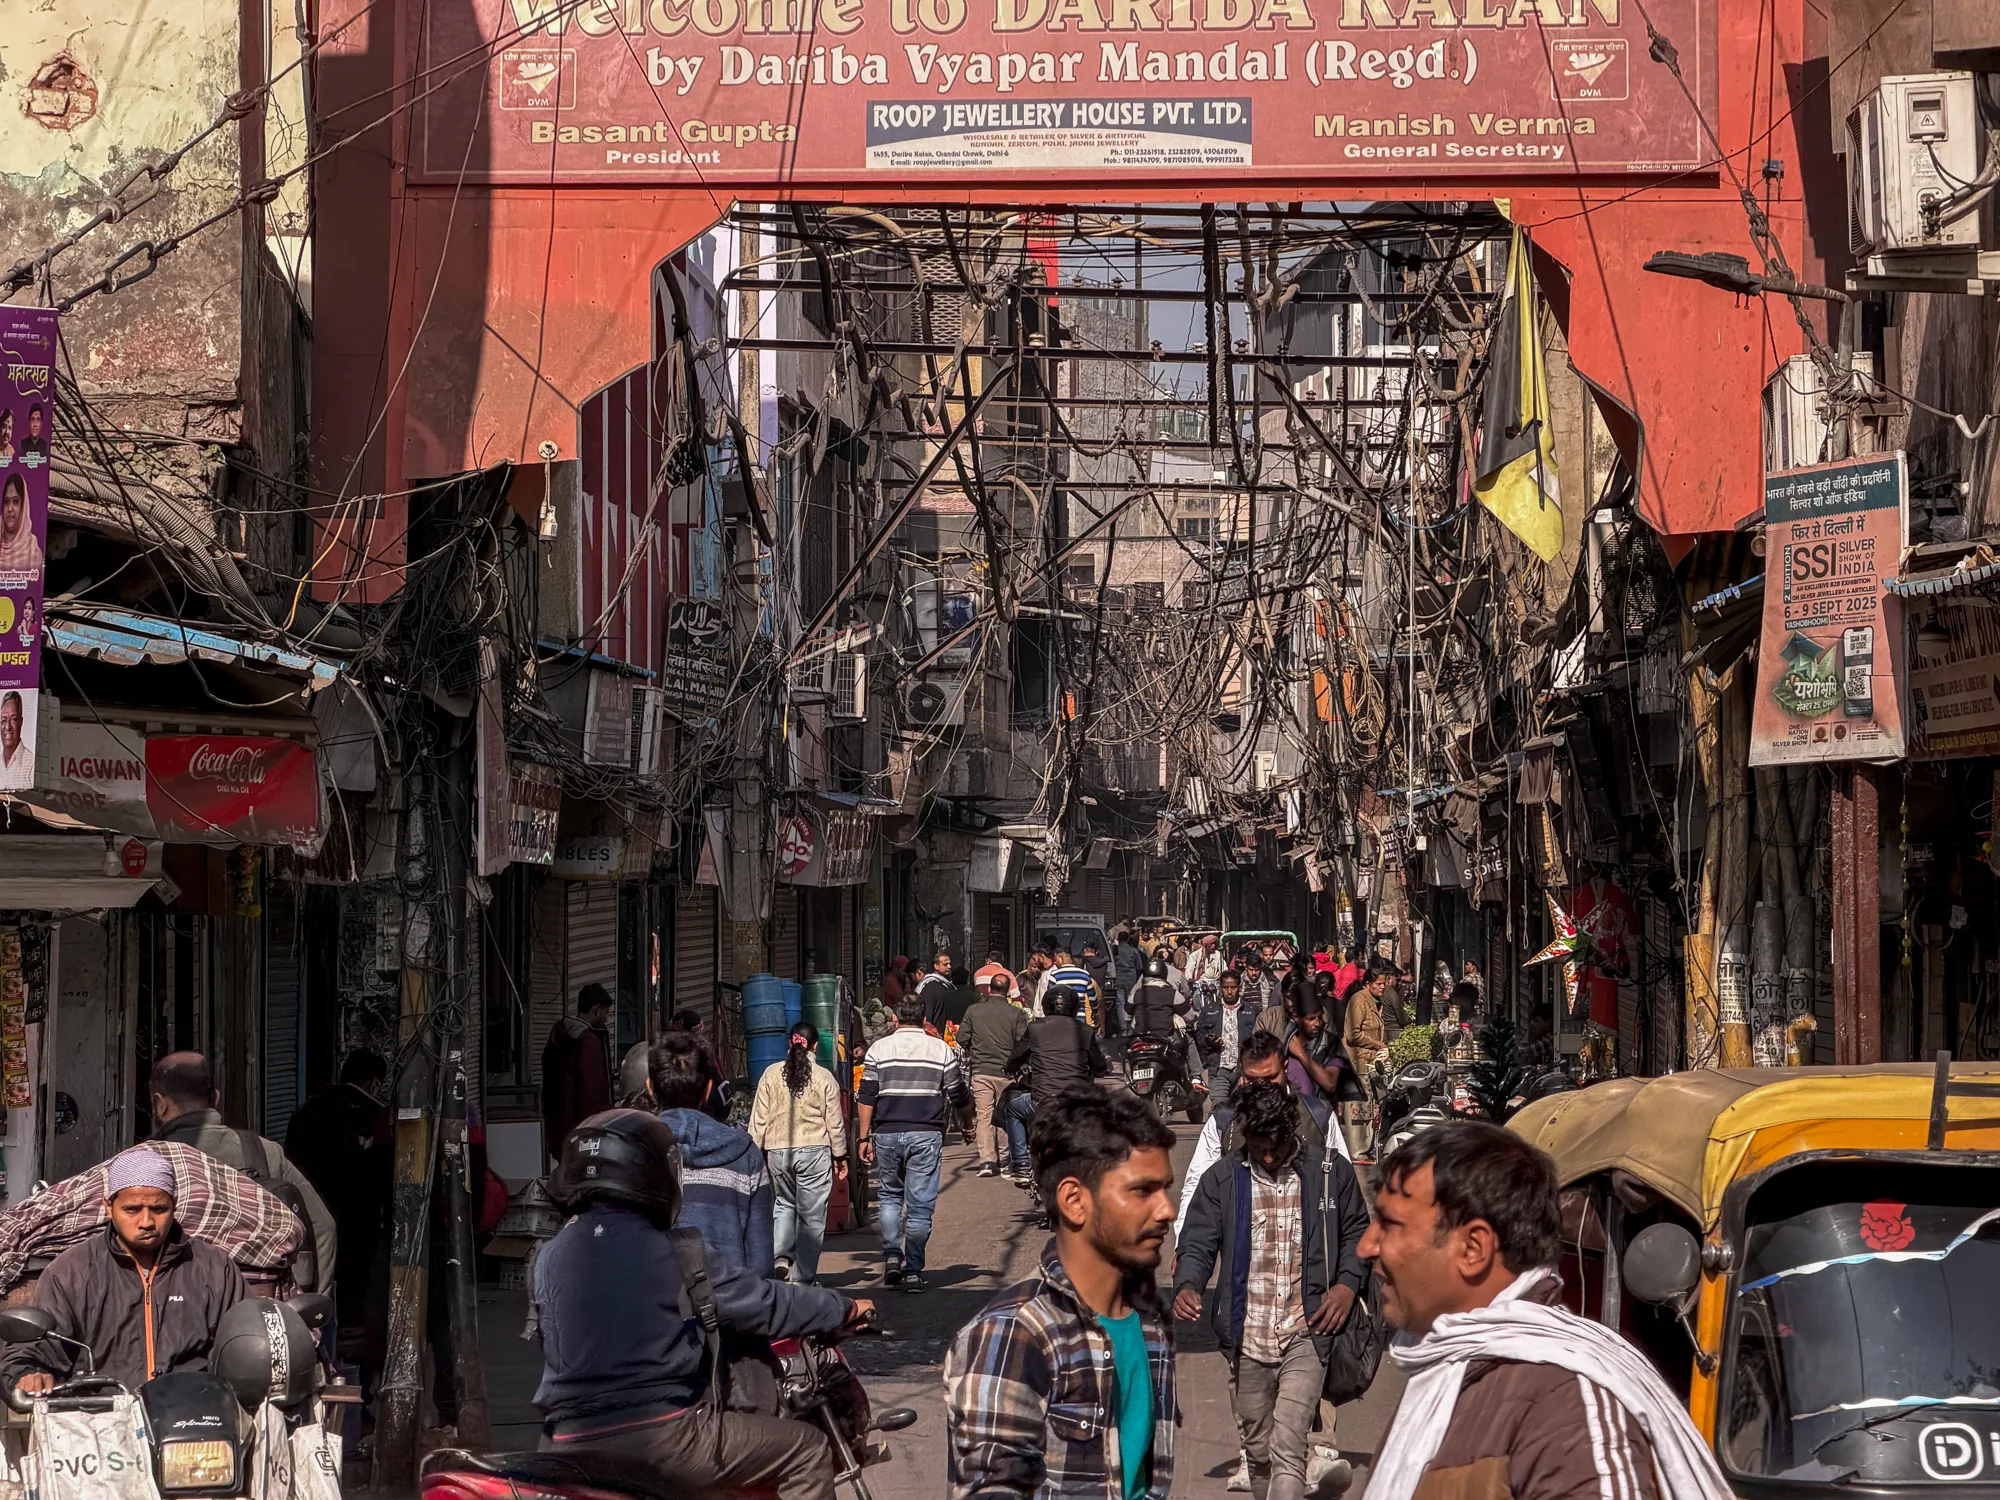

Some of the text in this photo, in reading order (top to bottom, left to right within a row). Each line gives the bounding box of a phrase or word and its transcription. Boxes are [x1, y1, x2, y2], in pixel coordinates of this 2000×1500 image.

[889, 0, 970, 35] to
[646, 37, 1479, 96] by Dariba Vyapar Mandal (Regd.)
[1580, 88, 1602, 98] DVM
[527, 98, 549, 107] DVM
[873, 101, 1248, 133] ROOP JEWELLERY HOUSE PVT. LTD.
[1313, 112, 1597, 138] Manish Verma
[530, 119, 798, 148] Basant Gupta
[963, 133, 1009, 142] WHOLESALE
[1018, 133, 1055, 141] RETAILER
[1105, 132, 1147, 140] ARTIFICIAL
[970, 141, 1006, 149] KUNDAN,
[1096, 140, 1139, 148] JEWELLERY
[1110, 148, 1123, 156] Ph.:
[1344, 142, 1566, 160] General Secretary
[606, 150, 720, 164] President
[891, 150, 913, 158] Dariba
[914, 150, 934, 158] Kalan,
[935, 150, 961, 158] Chandni
[962, 150, 985, 158] Chowk,
[986, 150, 1010, 158] Delhi-6
[1766, 487, 1785, 500] भारत
[1786, 483, 1795, 497] की
[1797, 480, 1814, 494] सबसे
[1850, 472, 1861, 487] की
[1790, 489, 1866, 511] सिल्वर शो ऑफ इंडिया
[1791, 514, 1866, 541] फिर से दिल्ली में
[1839, 538, 1876, 554] SILVER
[1793, 542, 1837, 581] SSI
[1838, 551, 1876, 564] SHOW OF
[1784, 546, 1792, 590] EDITION
[1839, 560, 1876, 576] INDIA
[1804, 582, 1830, 592] EXCLUSIVE
[1841, 577, 1871, 587] EXHIBITION
[1792, 594, 1800, 602] ON
[1801, 591, 1816, 600] SILVER
[1816, 588, 1846, 598] JEWELLERY
[1851, 585, 1877, 595] ARTICLES
[1784, 605, 1791, 619] 6
[1802, 603, 1810, 616] 9
[1812, 600, 1843, 616] SEPT
[1846, 596, 1877, 611] 2025
[1786, 617, 1829, 630] YASHOBHOOMI
[665, 676, 688, 692] LAL
[188, 743, 266, 784] Coca-Cola
[560, 847, 610, 861] BLES
[1463, 858, 1509, 880] STONES
